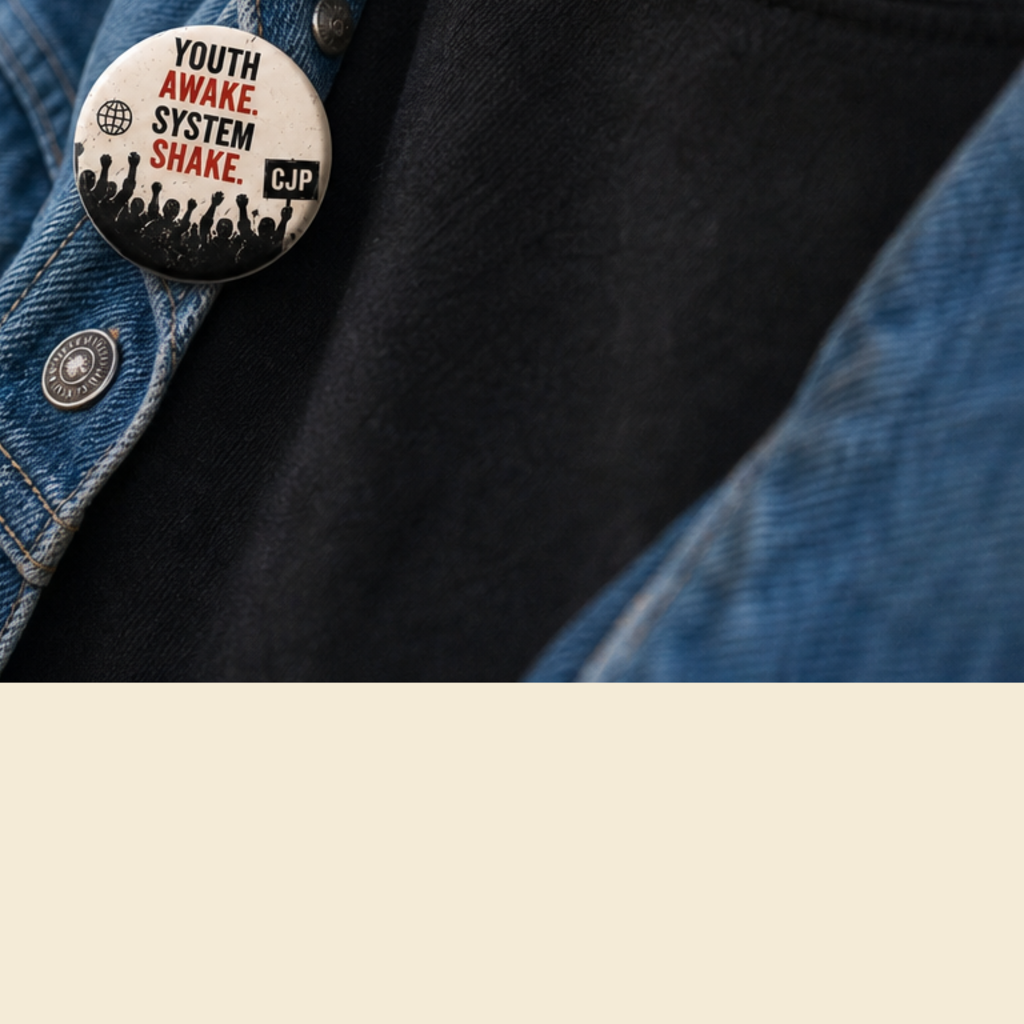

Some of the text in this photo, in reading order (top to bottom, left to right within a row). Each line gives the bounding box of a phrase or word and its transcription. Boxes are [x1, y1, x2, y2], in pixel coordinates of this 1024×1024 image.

[175, 37, 261, 81] YOUTH
[158, 70, 258, 116] AWAKE.
[152, 105, 255, 151] SYSTEM
[150, 139, 243, 185] SHAKE.
[271, 167, 313, 192] CJP
